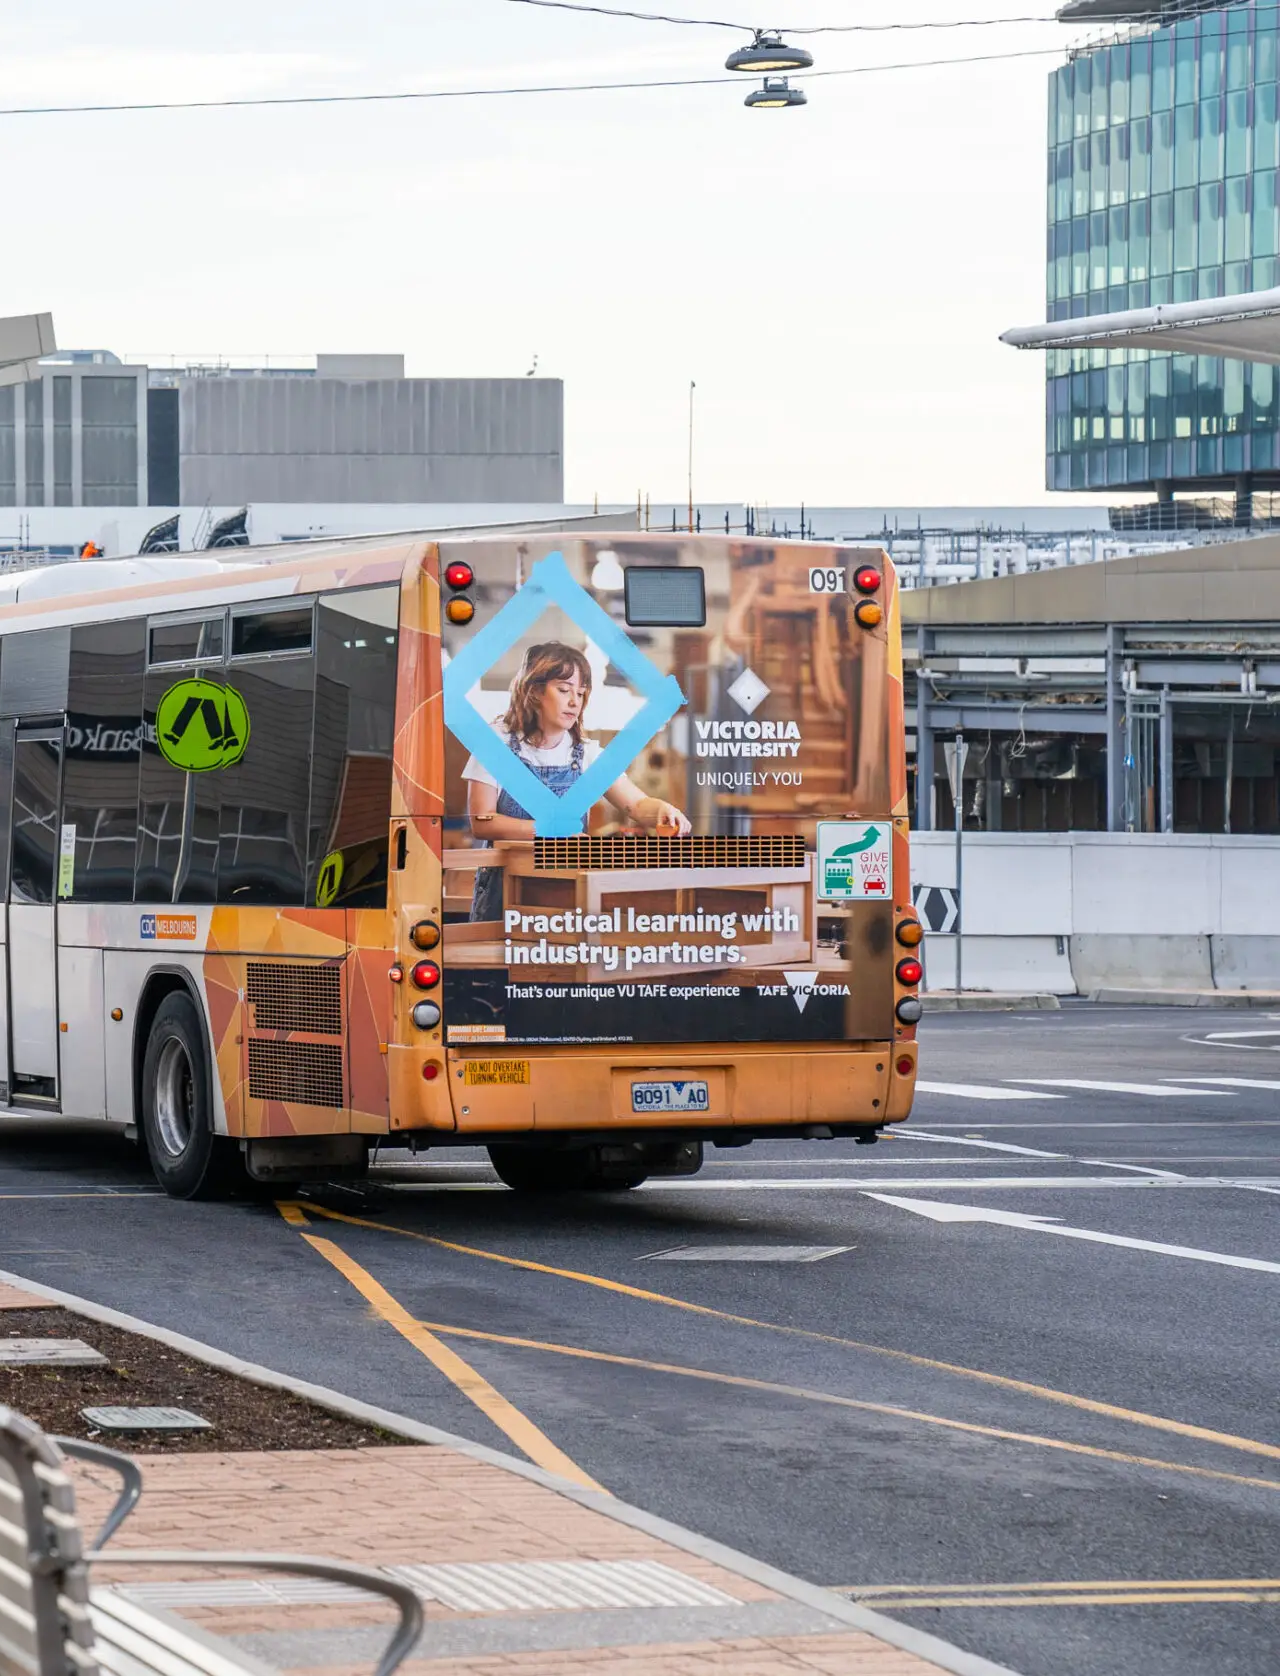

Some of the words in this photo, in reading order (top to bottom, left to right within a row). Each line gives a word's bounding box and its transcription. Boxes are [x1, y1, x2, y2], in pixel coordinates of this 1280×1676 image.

[811, 568, 846, 592] 091
[695, 720, 801, 740] VICTORIA
[696, 742, 801, 757] UNIVERSITY
[696, 772, 768, 789] UNIQUELY
[772, 771, 803, 786] YOU
[860, 852, 888, 862] GIVE
[860, 864, 888, 873] WAY
[141, 919, 155, 934] CDC
[156, 919, 196, 935] MELBOURNE
[504, 908, 620, 933] Practical
[627, 907, 737, 939] learning
[741, 907, 800, 932] with
[504, 938, 621, 971] industry
[625, 941, 748, 971] partners.
[505, 985, 543, 998] That's
[545, 987, 568, 998] our
[570, 985, 615, 1001] unique
[617, 985, 636, 997] VU
[637, 985, 667, 997] TAFE
[669, 984, 741, 1001] experience
[757, 985, 788, 996] TAFE
[788, 984, 851, 996] VICTORIA
[468, 1062, 478, 1072] DO
[480, 1062, 491, 1072] NOT
[493, 1061, 525, 1072] OVERTAKE
[470, 1073, 497, 1084] TURNING
[499, 1072, 525, 1084] VEHICLE
[634, 1089, 670, 1104] 8091
